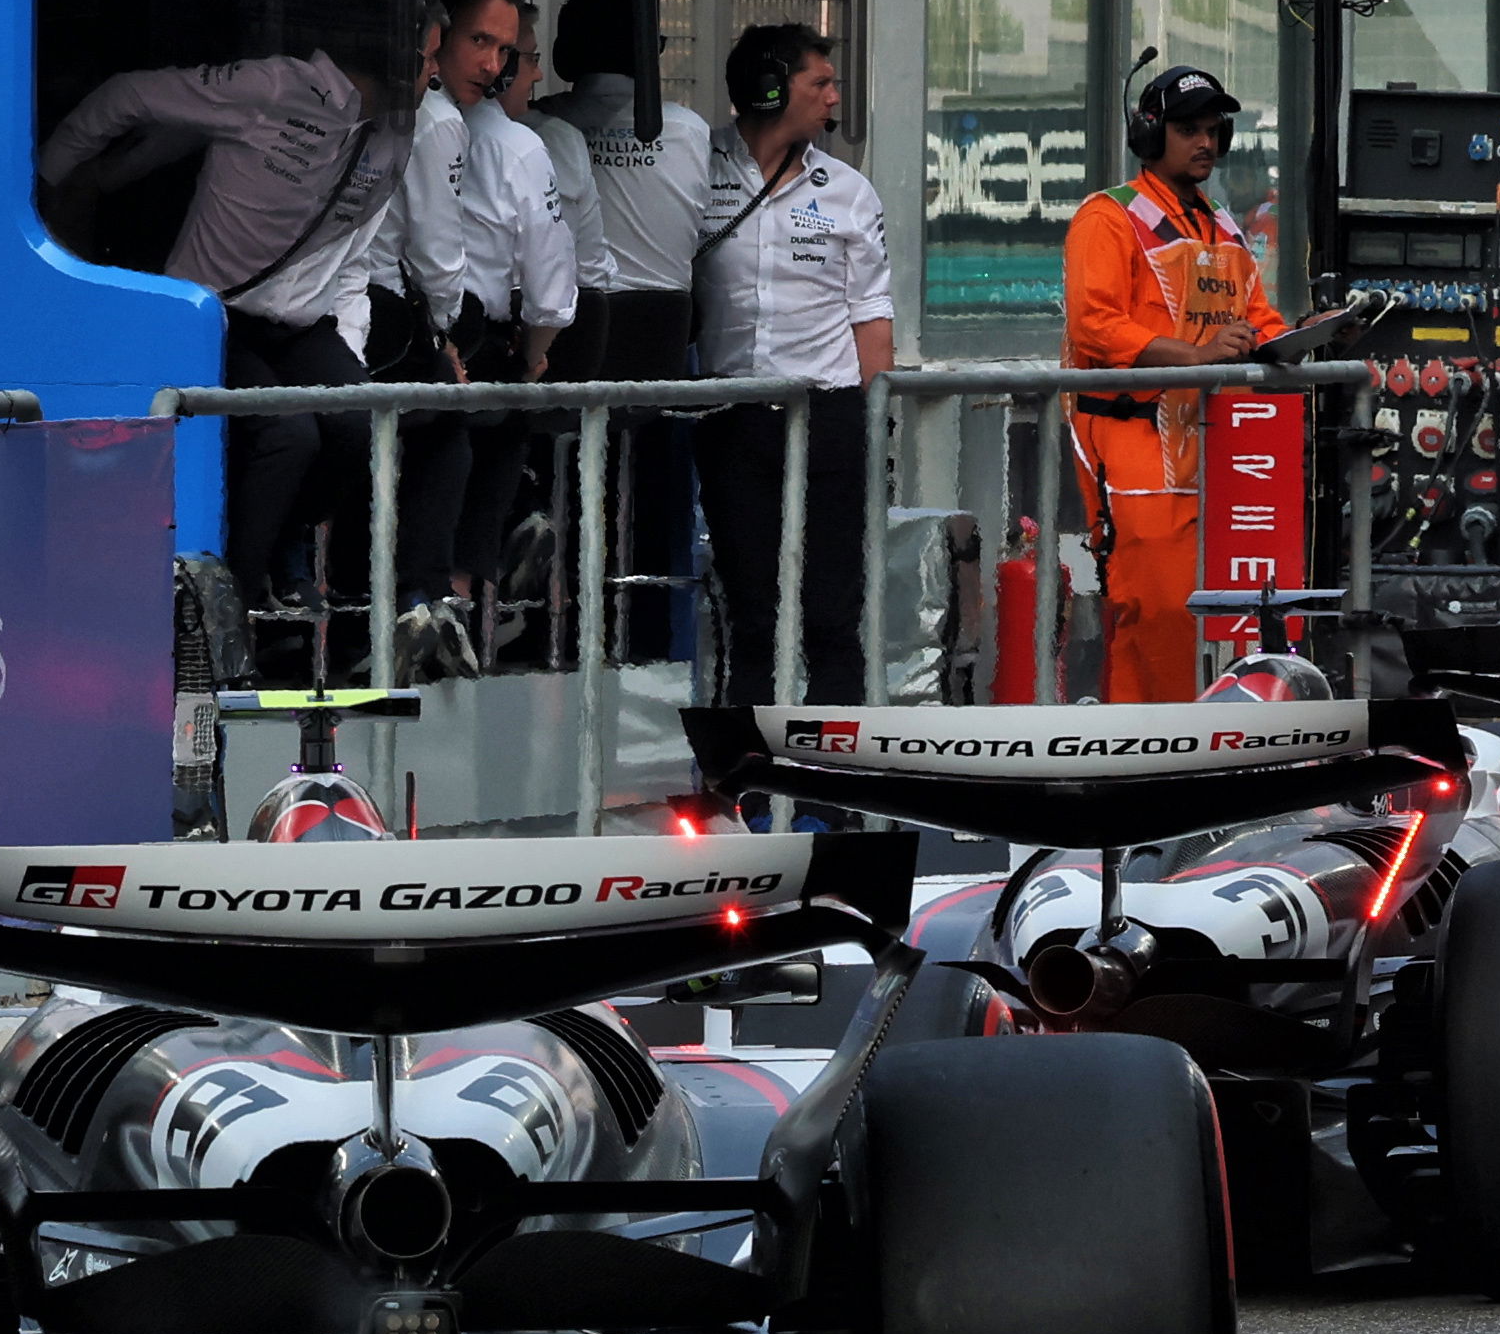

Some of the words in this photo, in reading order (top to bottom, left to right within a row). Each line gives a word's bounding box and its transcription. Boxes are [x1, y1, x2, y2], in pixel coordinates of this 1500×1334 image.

[587, 139, 664, 154] WILLIAMS
[592, 155, 656, 167] RACING
[790, 205, 836, 224] ATLASSIAN
[790, 214, 837, 230] WILLIAMS
[793, 221, 832, 234] RACING
[793, 251, 827, 264] betway
[787, 731, 858, 753] GR
[872, 736, 1034, 757] TOYOTA
[1048, 735, 1199, 757] GAZOO
[1210, 727, 1351, 753] Racing
[18, 879, 121, 909] GR
[138, 882, 361, 913] TOYOTA
[379, 879, 583, 911] GAZOO
[596, 870, 782, 903] Racing
